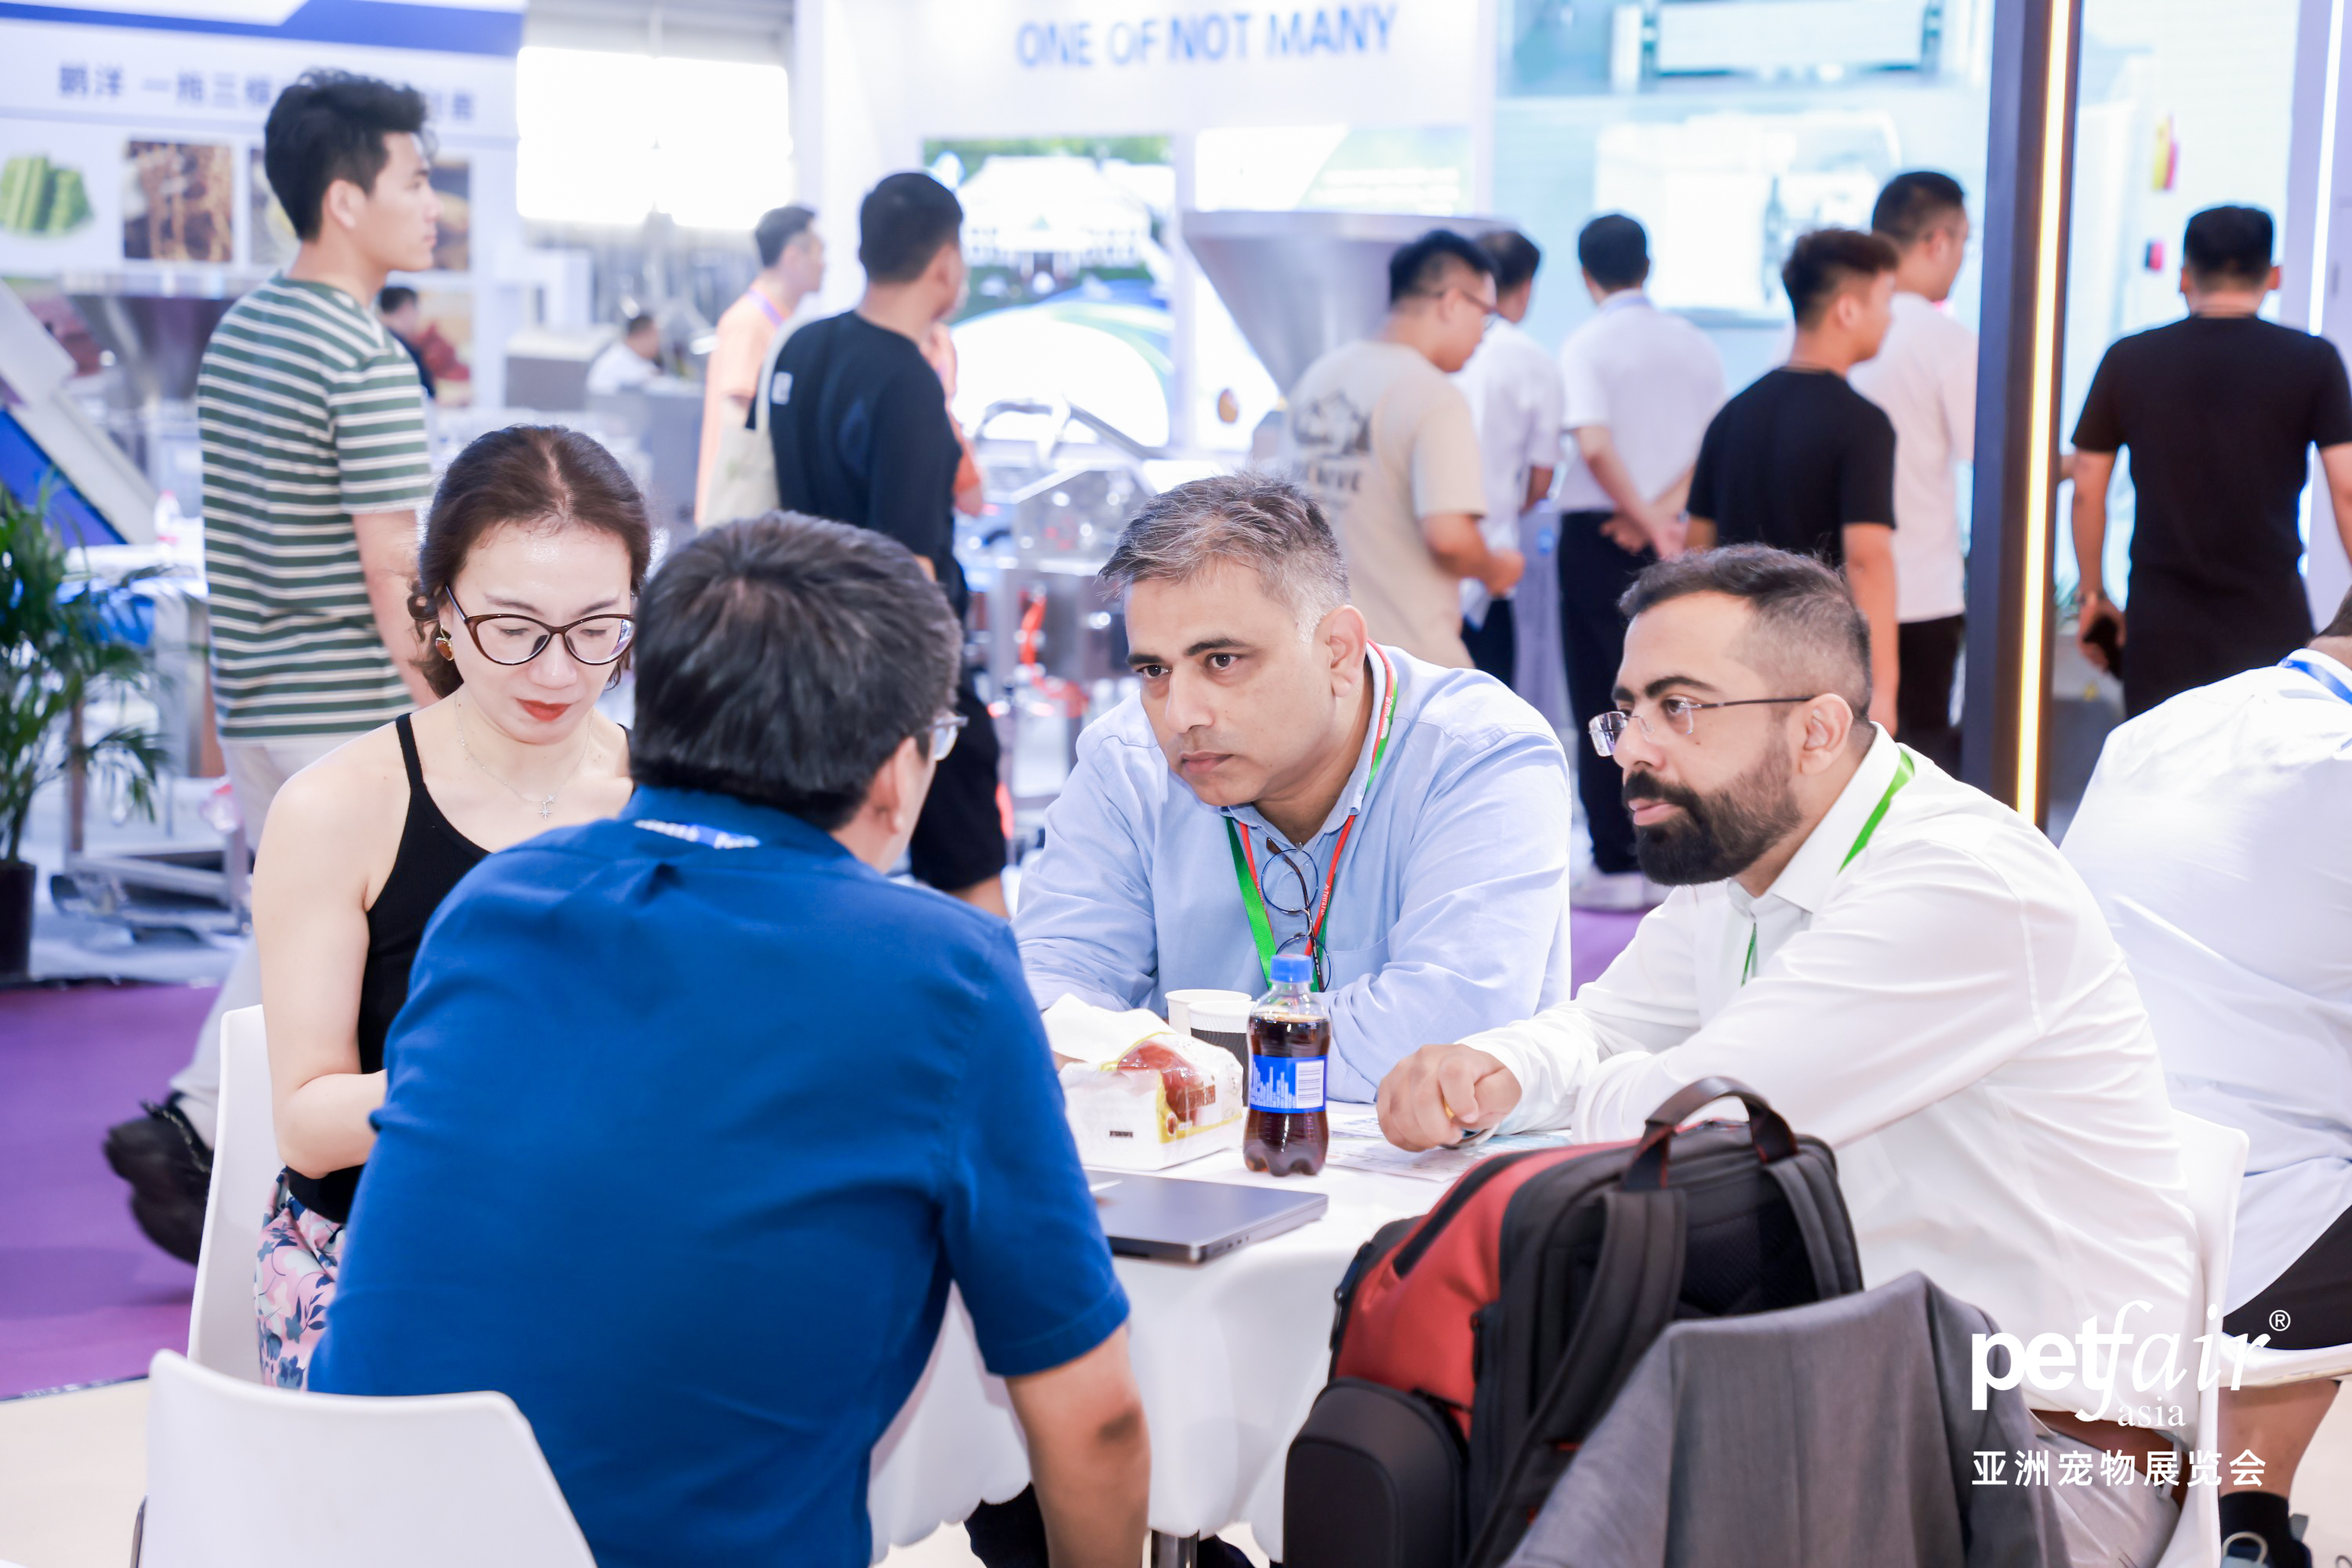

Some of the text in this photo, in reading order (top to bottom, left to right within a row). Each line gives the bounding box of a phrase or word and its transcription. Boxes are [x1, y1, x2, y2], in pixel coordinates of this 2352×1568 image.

[1017, 5, 1398, 66] ONE OF NOT MANY
